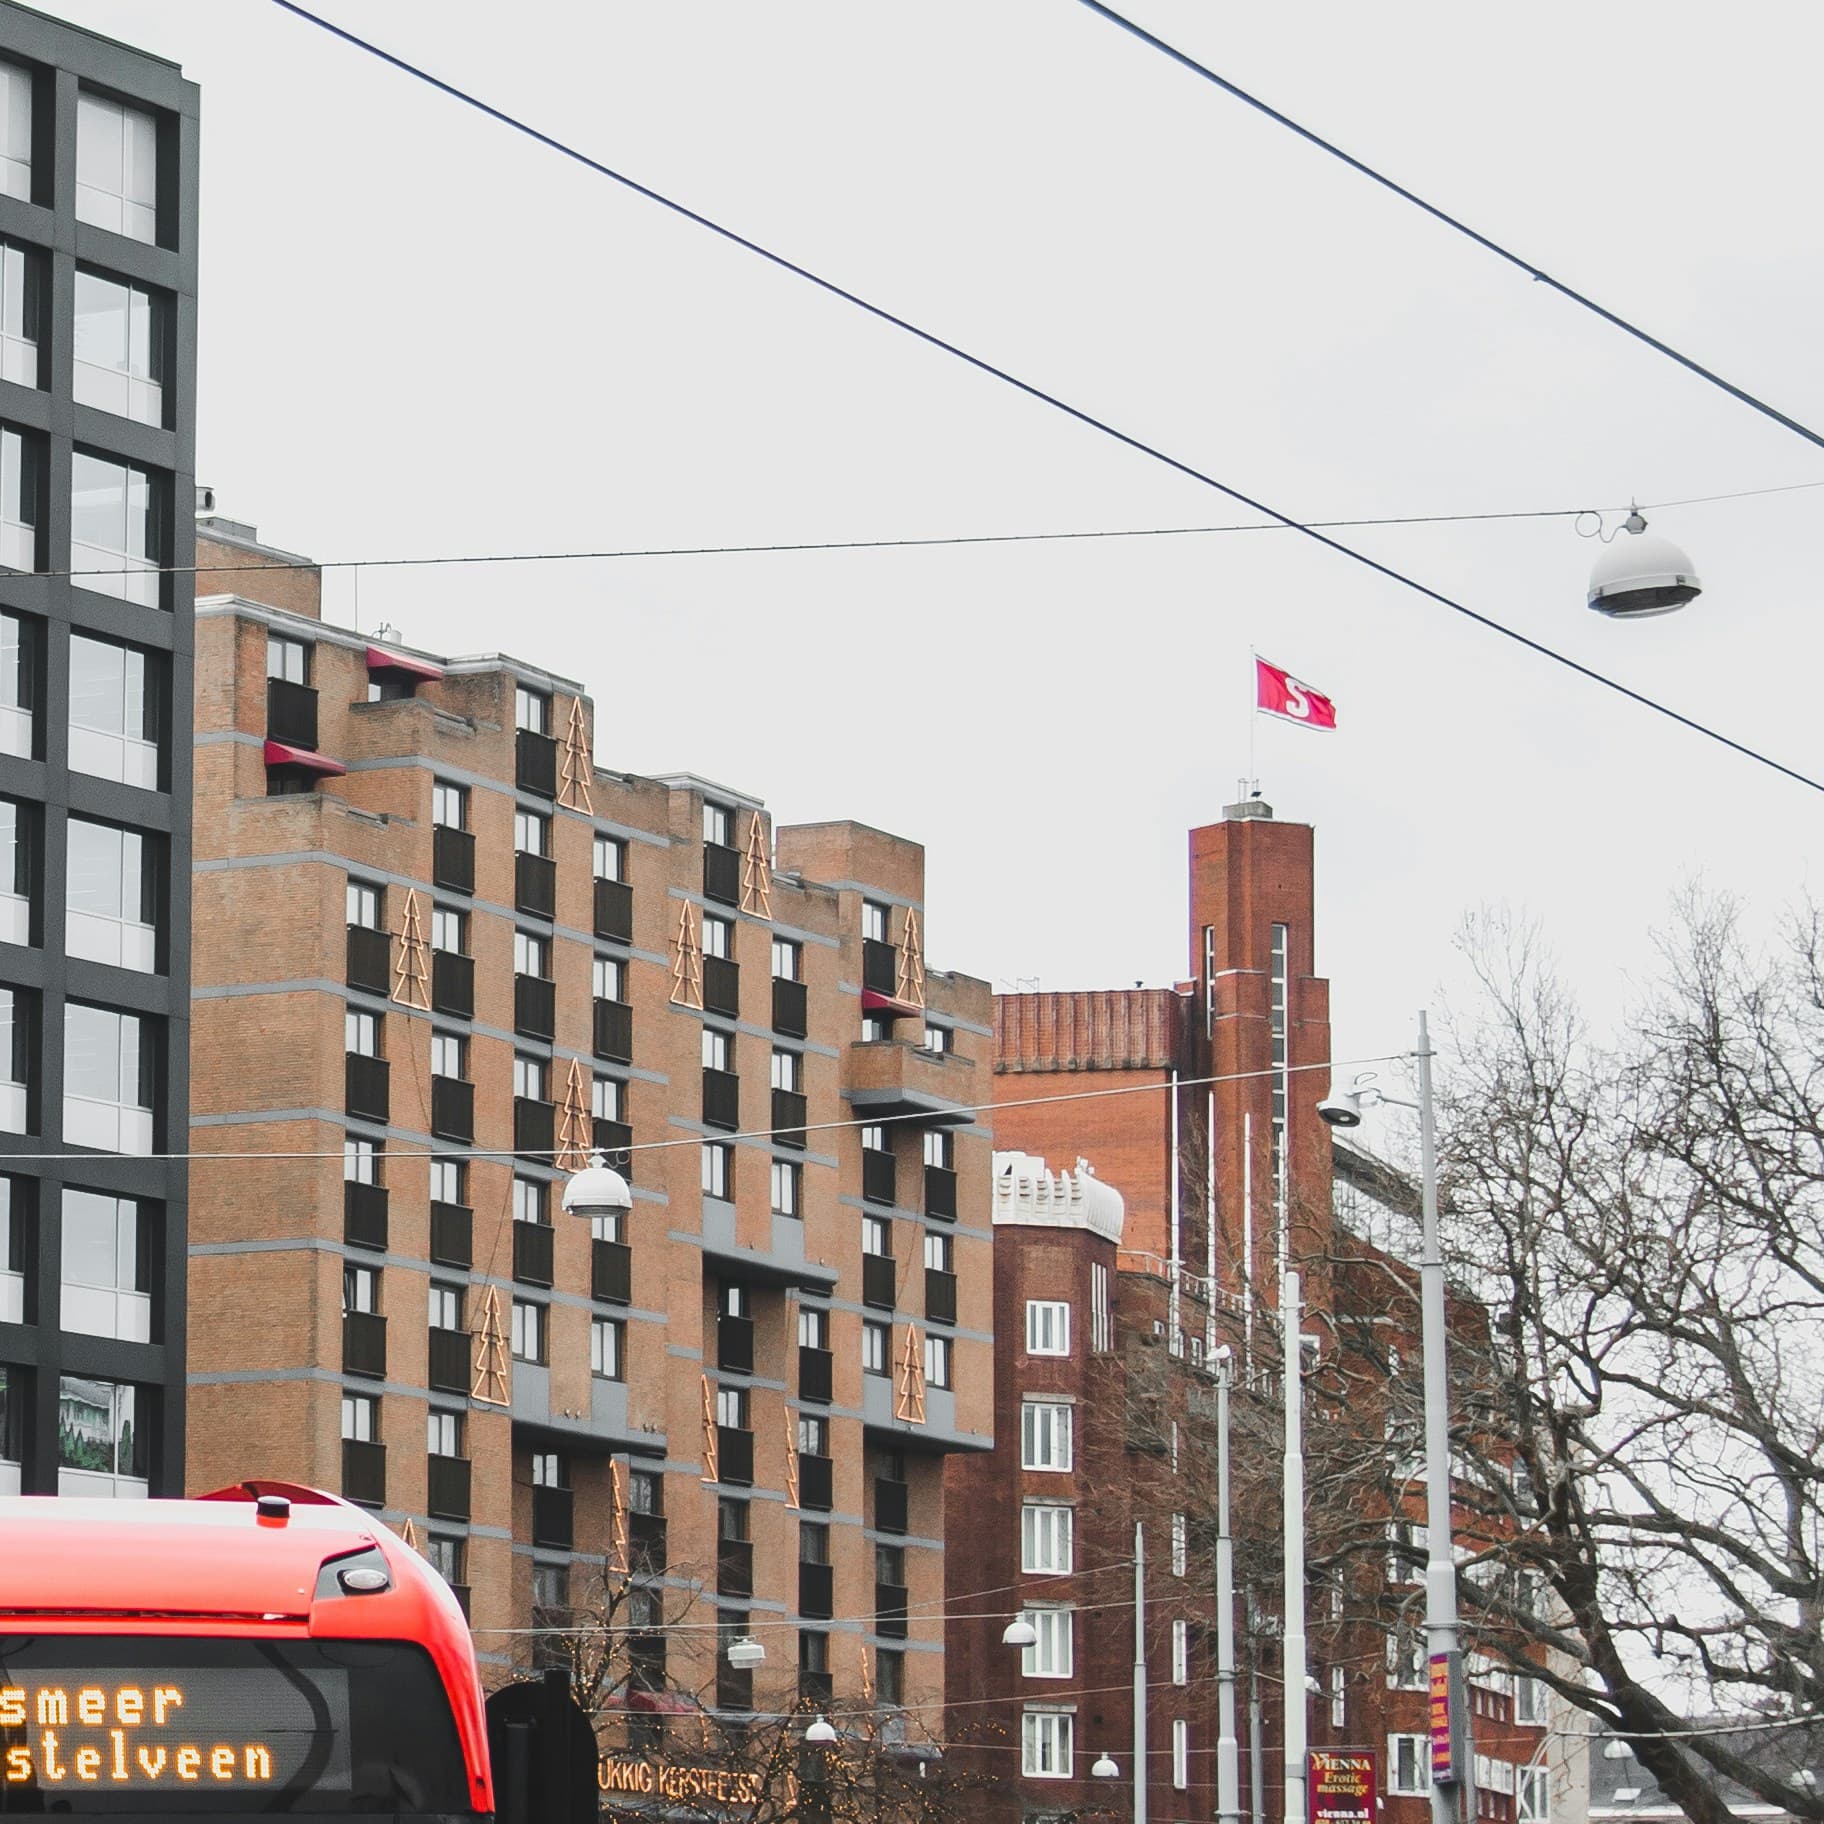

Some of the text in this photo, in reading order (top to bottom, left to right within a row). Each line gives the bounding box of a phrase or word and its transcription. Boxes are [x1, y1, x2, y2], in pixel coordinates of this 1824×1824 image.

[1284, 676, 1310, 717] S
[1310, 1752, 1372, 1771] VIENNA
[1324, 1771, 1362, 1784] Erotic
